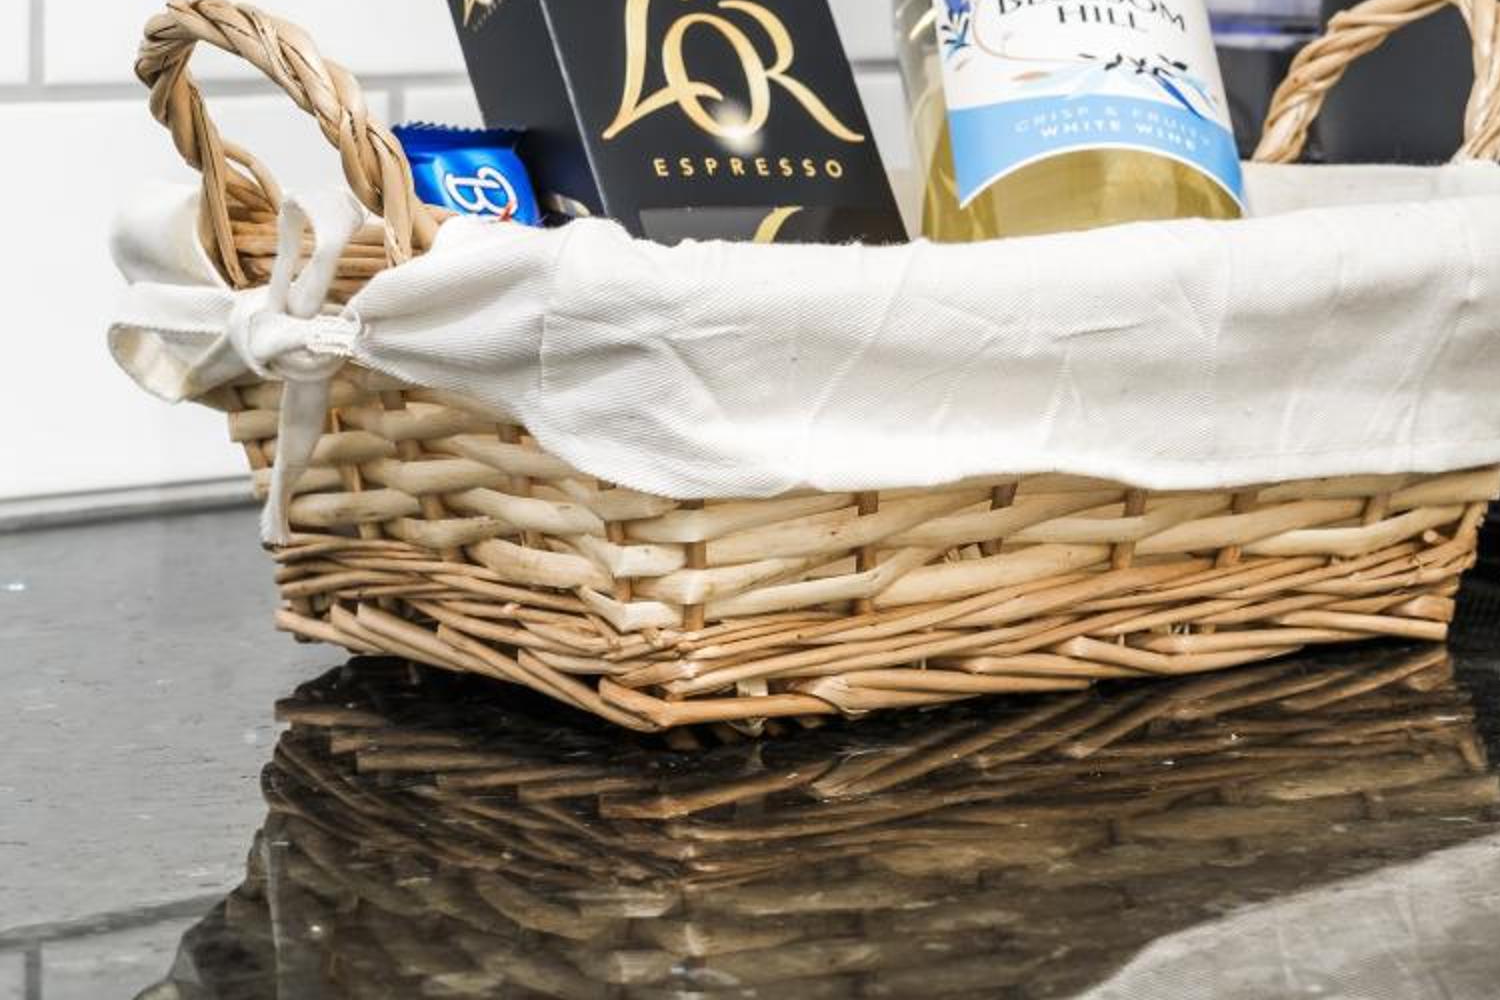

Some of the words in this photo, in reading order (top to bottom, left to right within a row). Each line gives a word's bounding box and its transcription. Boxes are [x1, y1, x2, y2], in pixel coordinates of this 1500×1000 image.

[1056, 4, 1149, 33] HILL
[1040, 119, 1121, 138] WHITE
[653, 157, 845, 180] ESPRESSO
